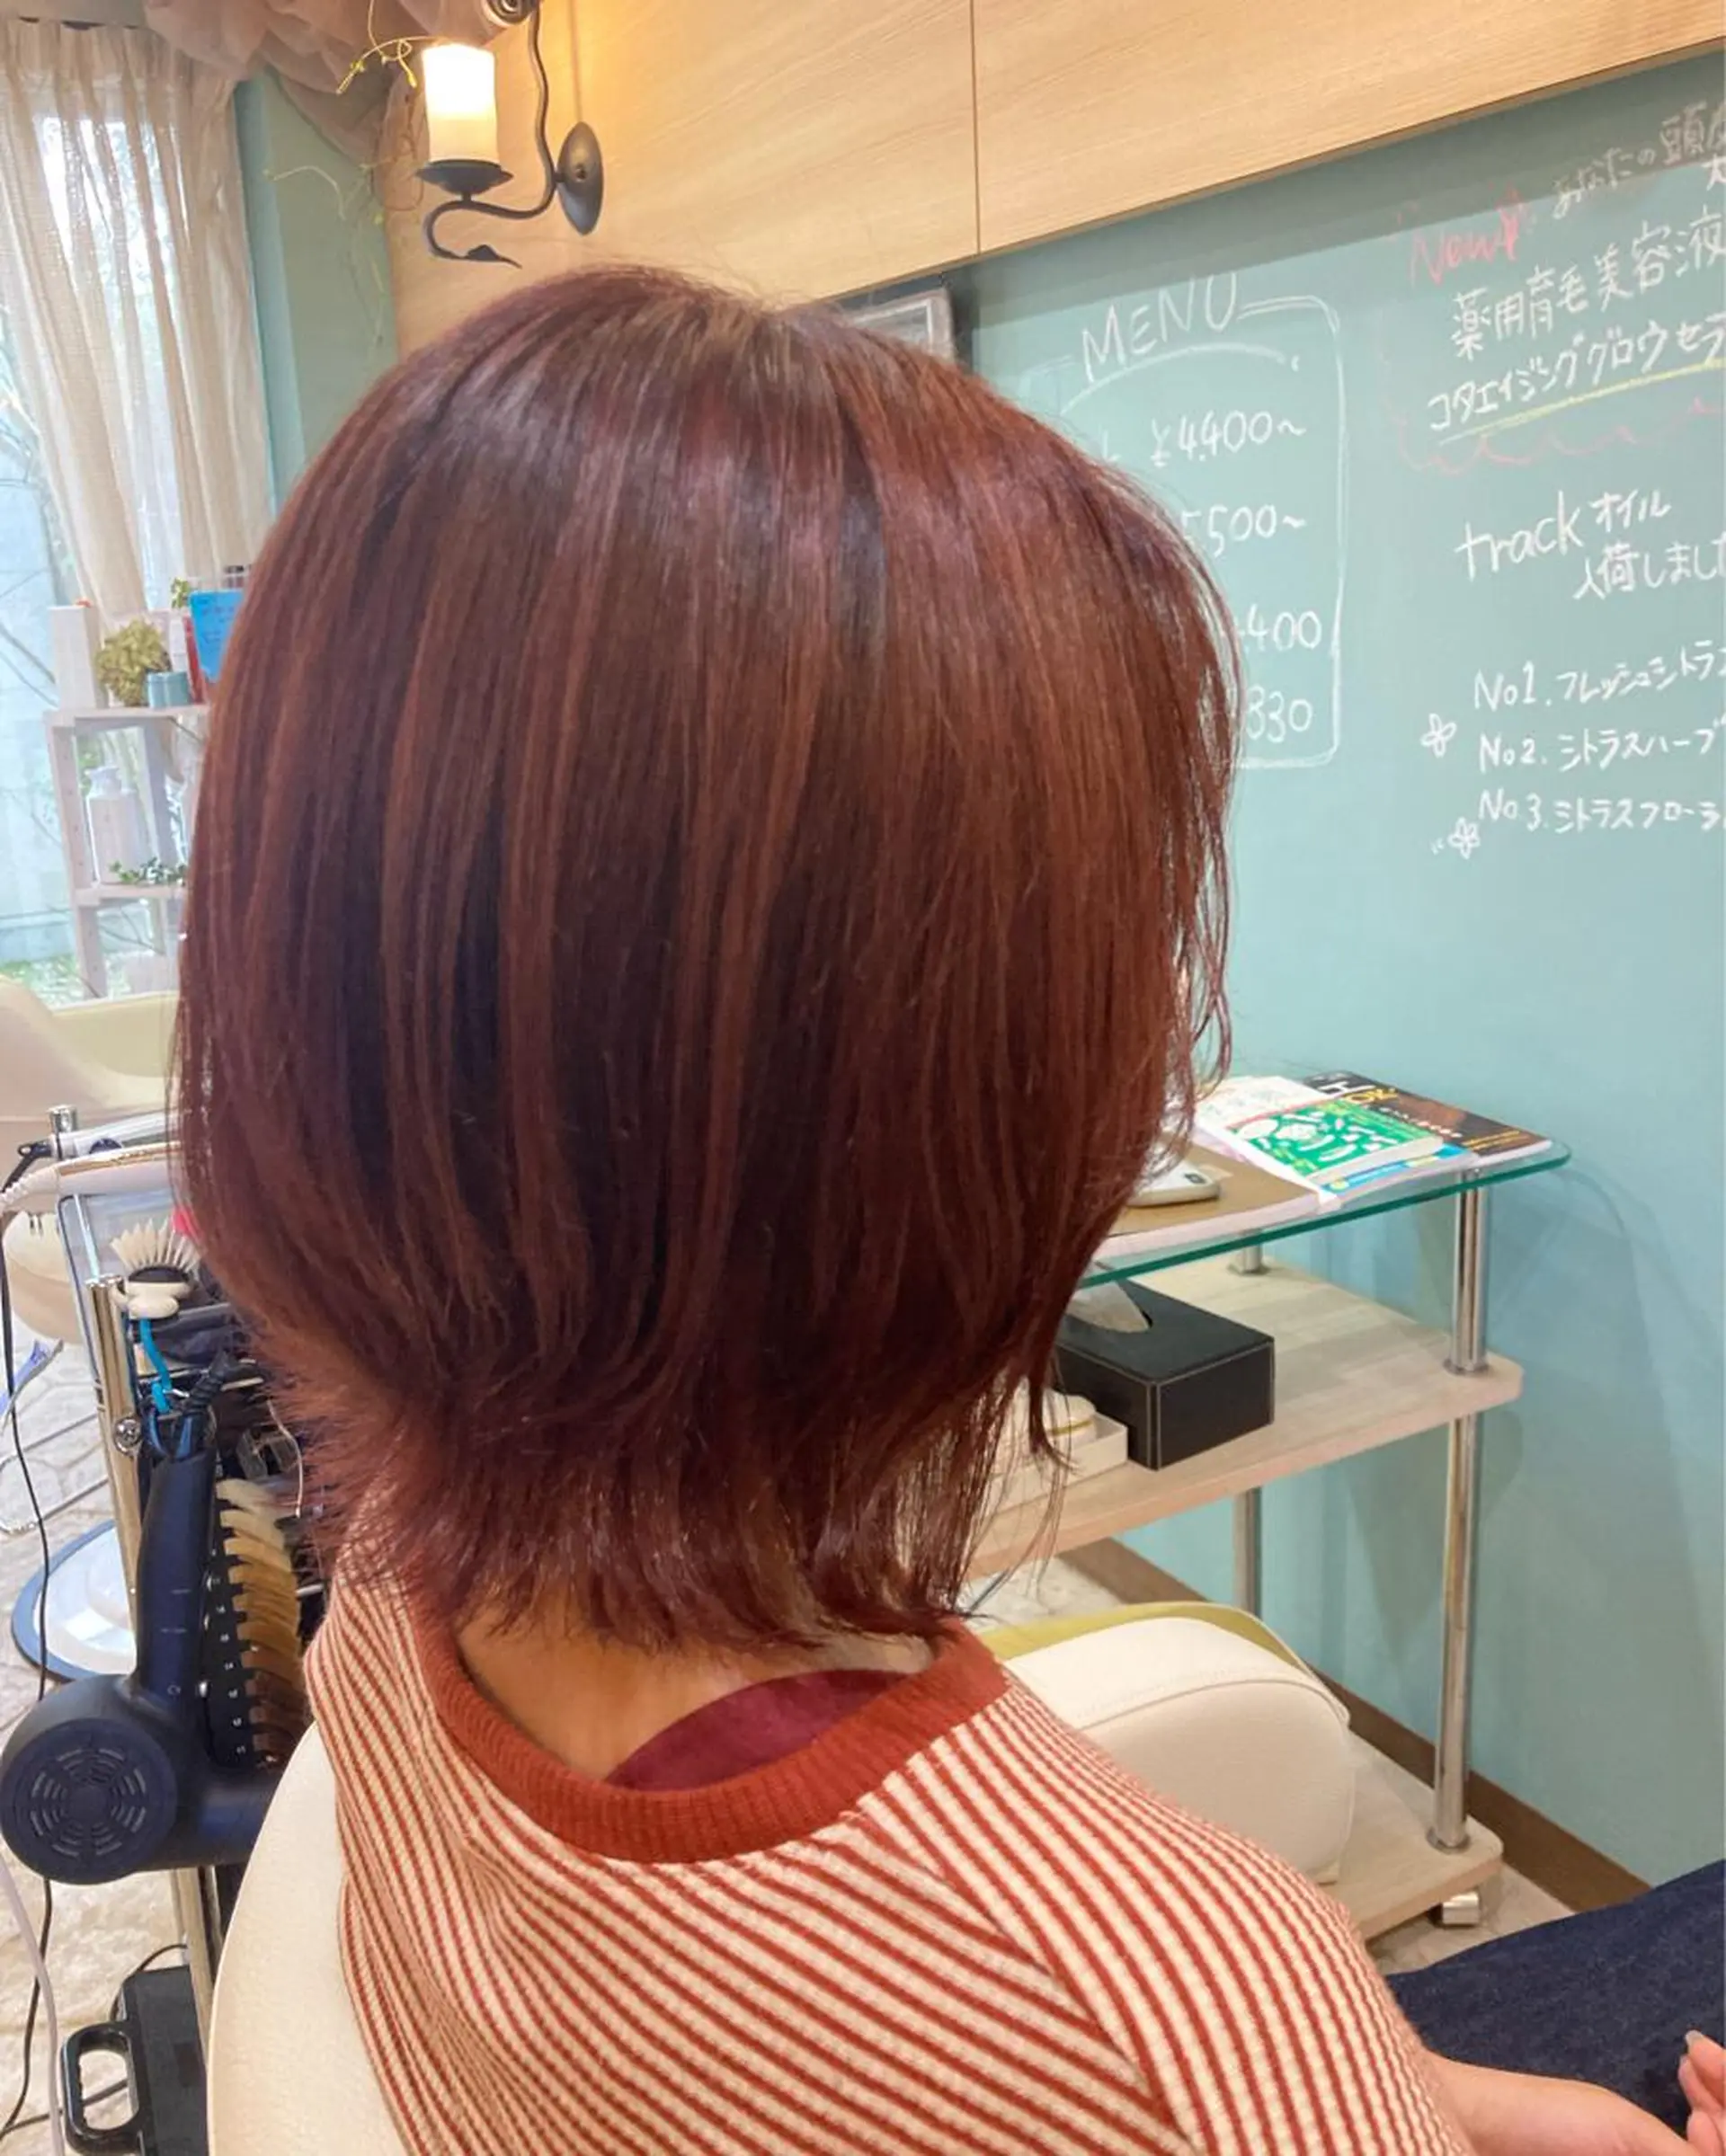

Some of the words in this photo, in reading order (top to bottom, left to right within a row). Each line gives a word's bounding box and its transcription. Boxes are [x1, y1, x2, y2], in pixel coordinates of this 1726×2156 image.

[1081, 272, 1238, 384] MENU
[1453, 489, 1585, 583] track
[1588, 488, 1673, 533] オイル
[1553, 797, 1725, 833] シトラスフローラ
